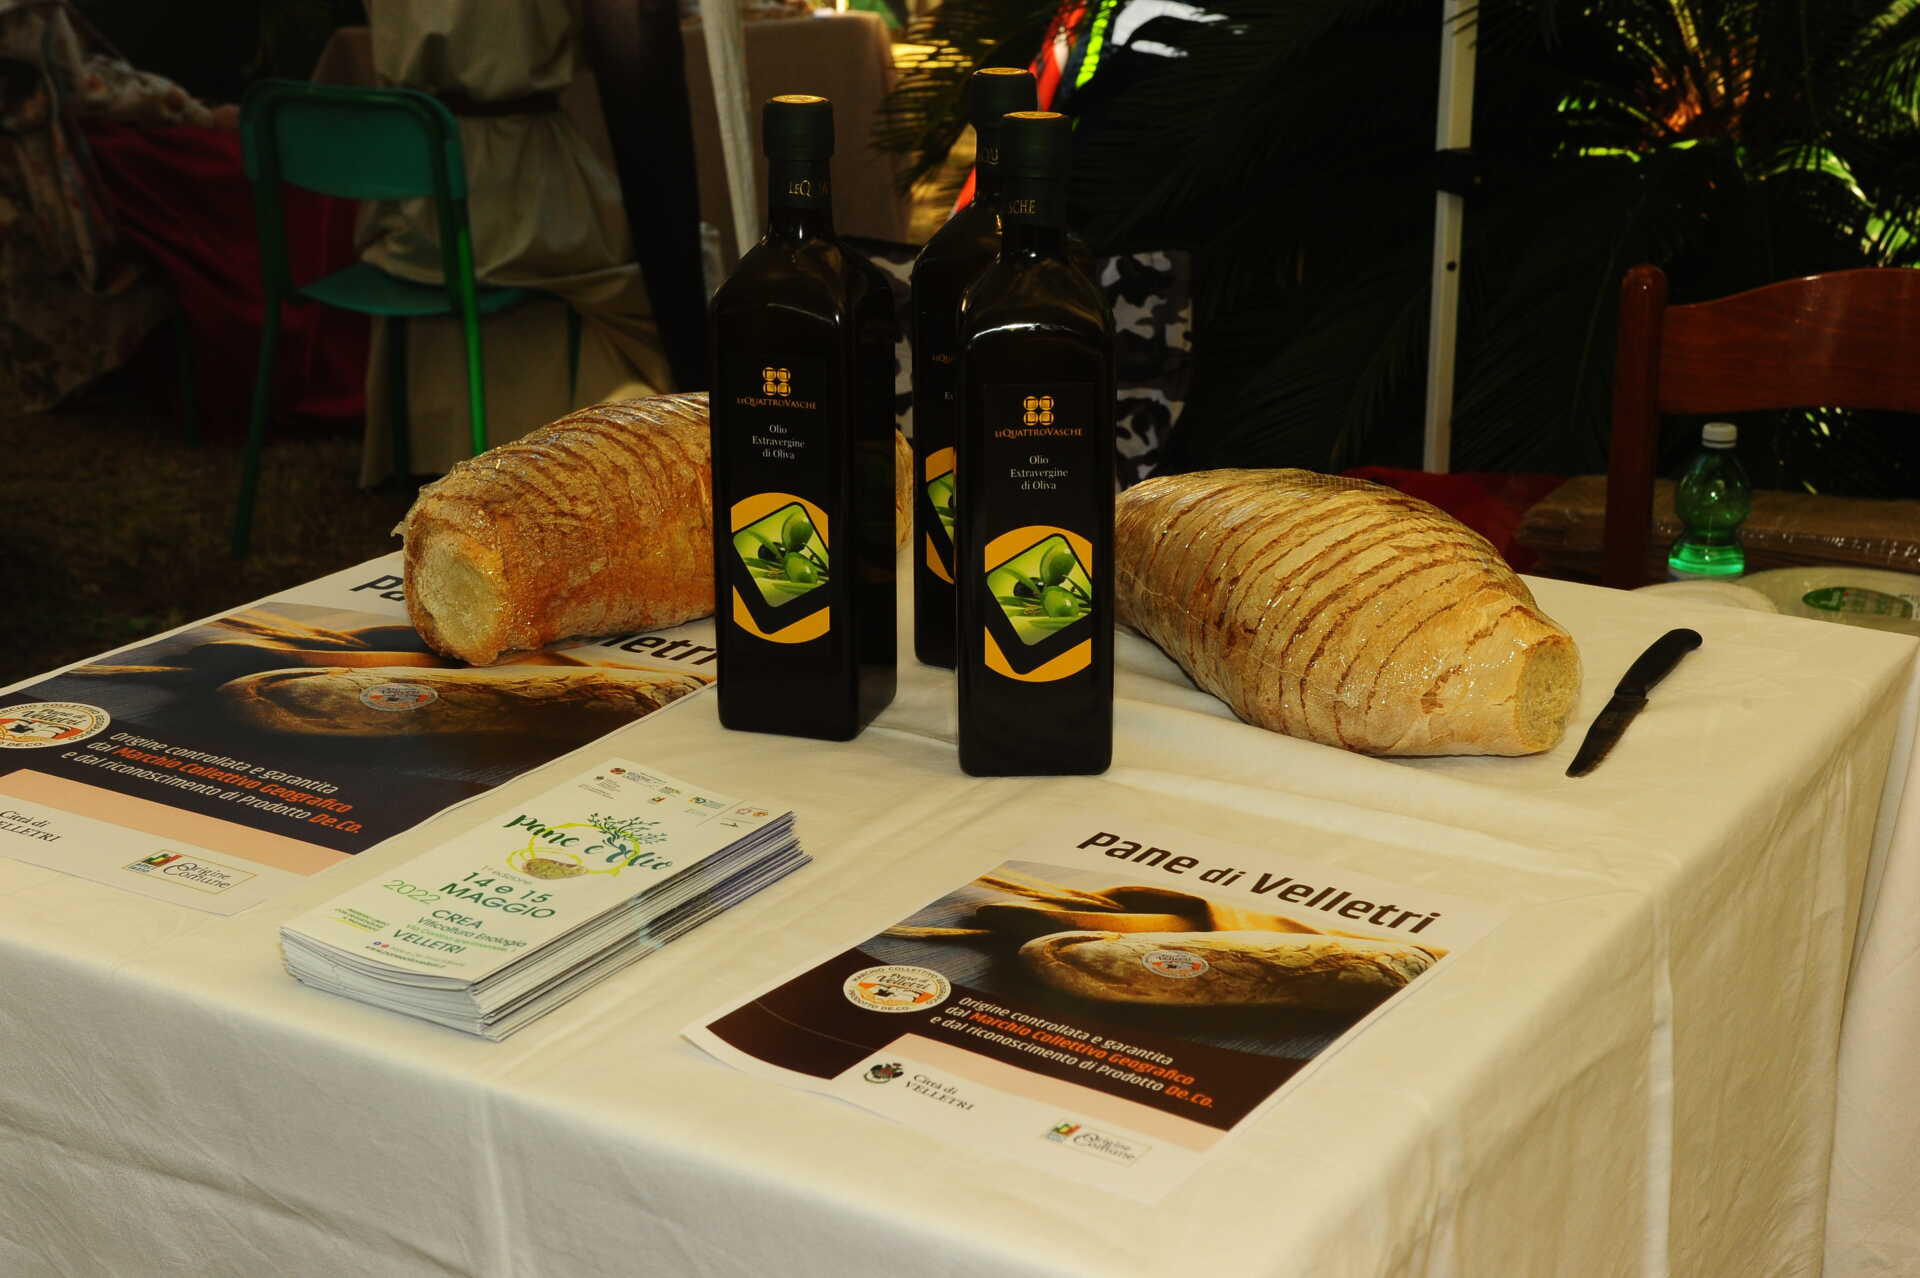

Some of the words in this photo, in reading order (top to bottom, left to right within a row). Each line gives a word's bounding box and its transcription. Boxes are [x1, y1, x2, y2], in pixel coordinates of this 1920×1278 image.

[769, 423, 788, 433] Olio
[752, 435, 806, 448] Extravergine
[762, 448, 771, 458] di
[772, 449, 796, 460] Oliva
[1010, 467, 1068, 479] Extravergine
[1029, 455, 1049, 465] Olio
[1021, 480, 1031, 490] di
[1032, 480, 1057, 490] Oliva
[110, 732, 168, 750] Origine
[165, 746, 251, 771] controllata
[250, 767, 264, 775] e
[259, 768, 339, 794] garantita
[86, 741, 120, 753] dal
[112, 747, 183, 769] Marchio
[178, 762, 263, 789] Collettivo
[259, 783, 353, 813] Geografico
[61, 751, 77, 760] e
[73, 753, 106, 766] dal
[99, 759, 222, 796] riconoscimento
[219, 789, 244, 801] di
[238, 794, 312, 819] Prodotto
[308, 813, 363, 834] De.Co.
[163, 864, 231, 888] Comune
[462, 871, 496, 888] 14
[520, 889, 553, 903] 15
[1076, 831, 1199, 874] Pane
[1199, 867, 1247, 887] di
[1250, 873, 1442, 934] Velletri
[384, 879, 441, 905] 2022
[439, 883, 556, 919] MAGGIO
[431, 909, 484, 930] CREA
[392, 929, 467, 954] VELLETRI
[958, 997, 1010, 1017] Origine
[1010, 1012, 1090, 1041] controllata
[1090, 1036, 1103, 1045] e
[1100, 1039, 1174, 1066] garantita
[945, 1006, 972, 1018] dal
[969, 1012, 1032, 1037] Marchio
[1031, 1030, 1109, 1060] Collettivo
[1107, 1053, 1196, 1085] Geografico
[930, 1016, 942, 1024] e
[941, 1018, 968, 1031] dal
[966, 1025, 1078, 1066] riconoscimento
[1078, 1060, 1097, 1071] di
[1096, 1064, 1164, 1092] Prodotto
[1164, 1085, 1213, 1109] De.Co.
[905, 1081, 974, 1110] VELLETRI
[943, 1087, 958, 1095] di
